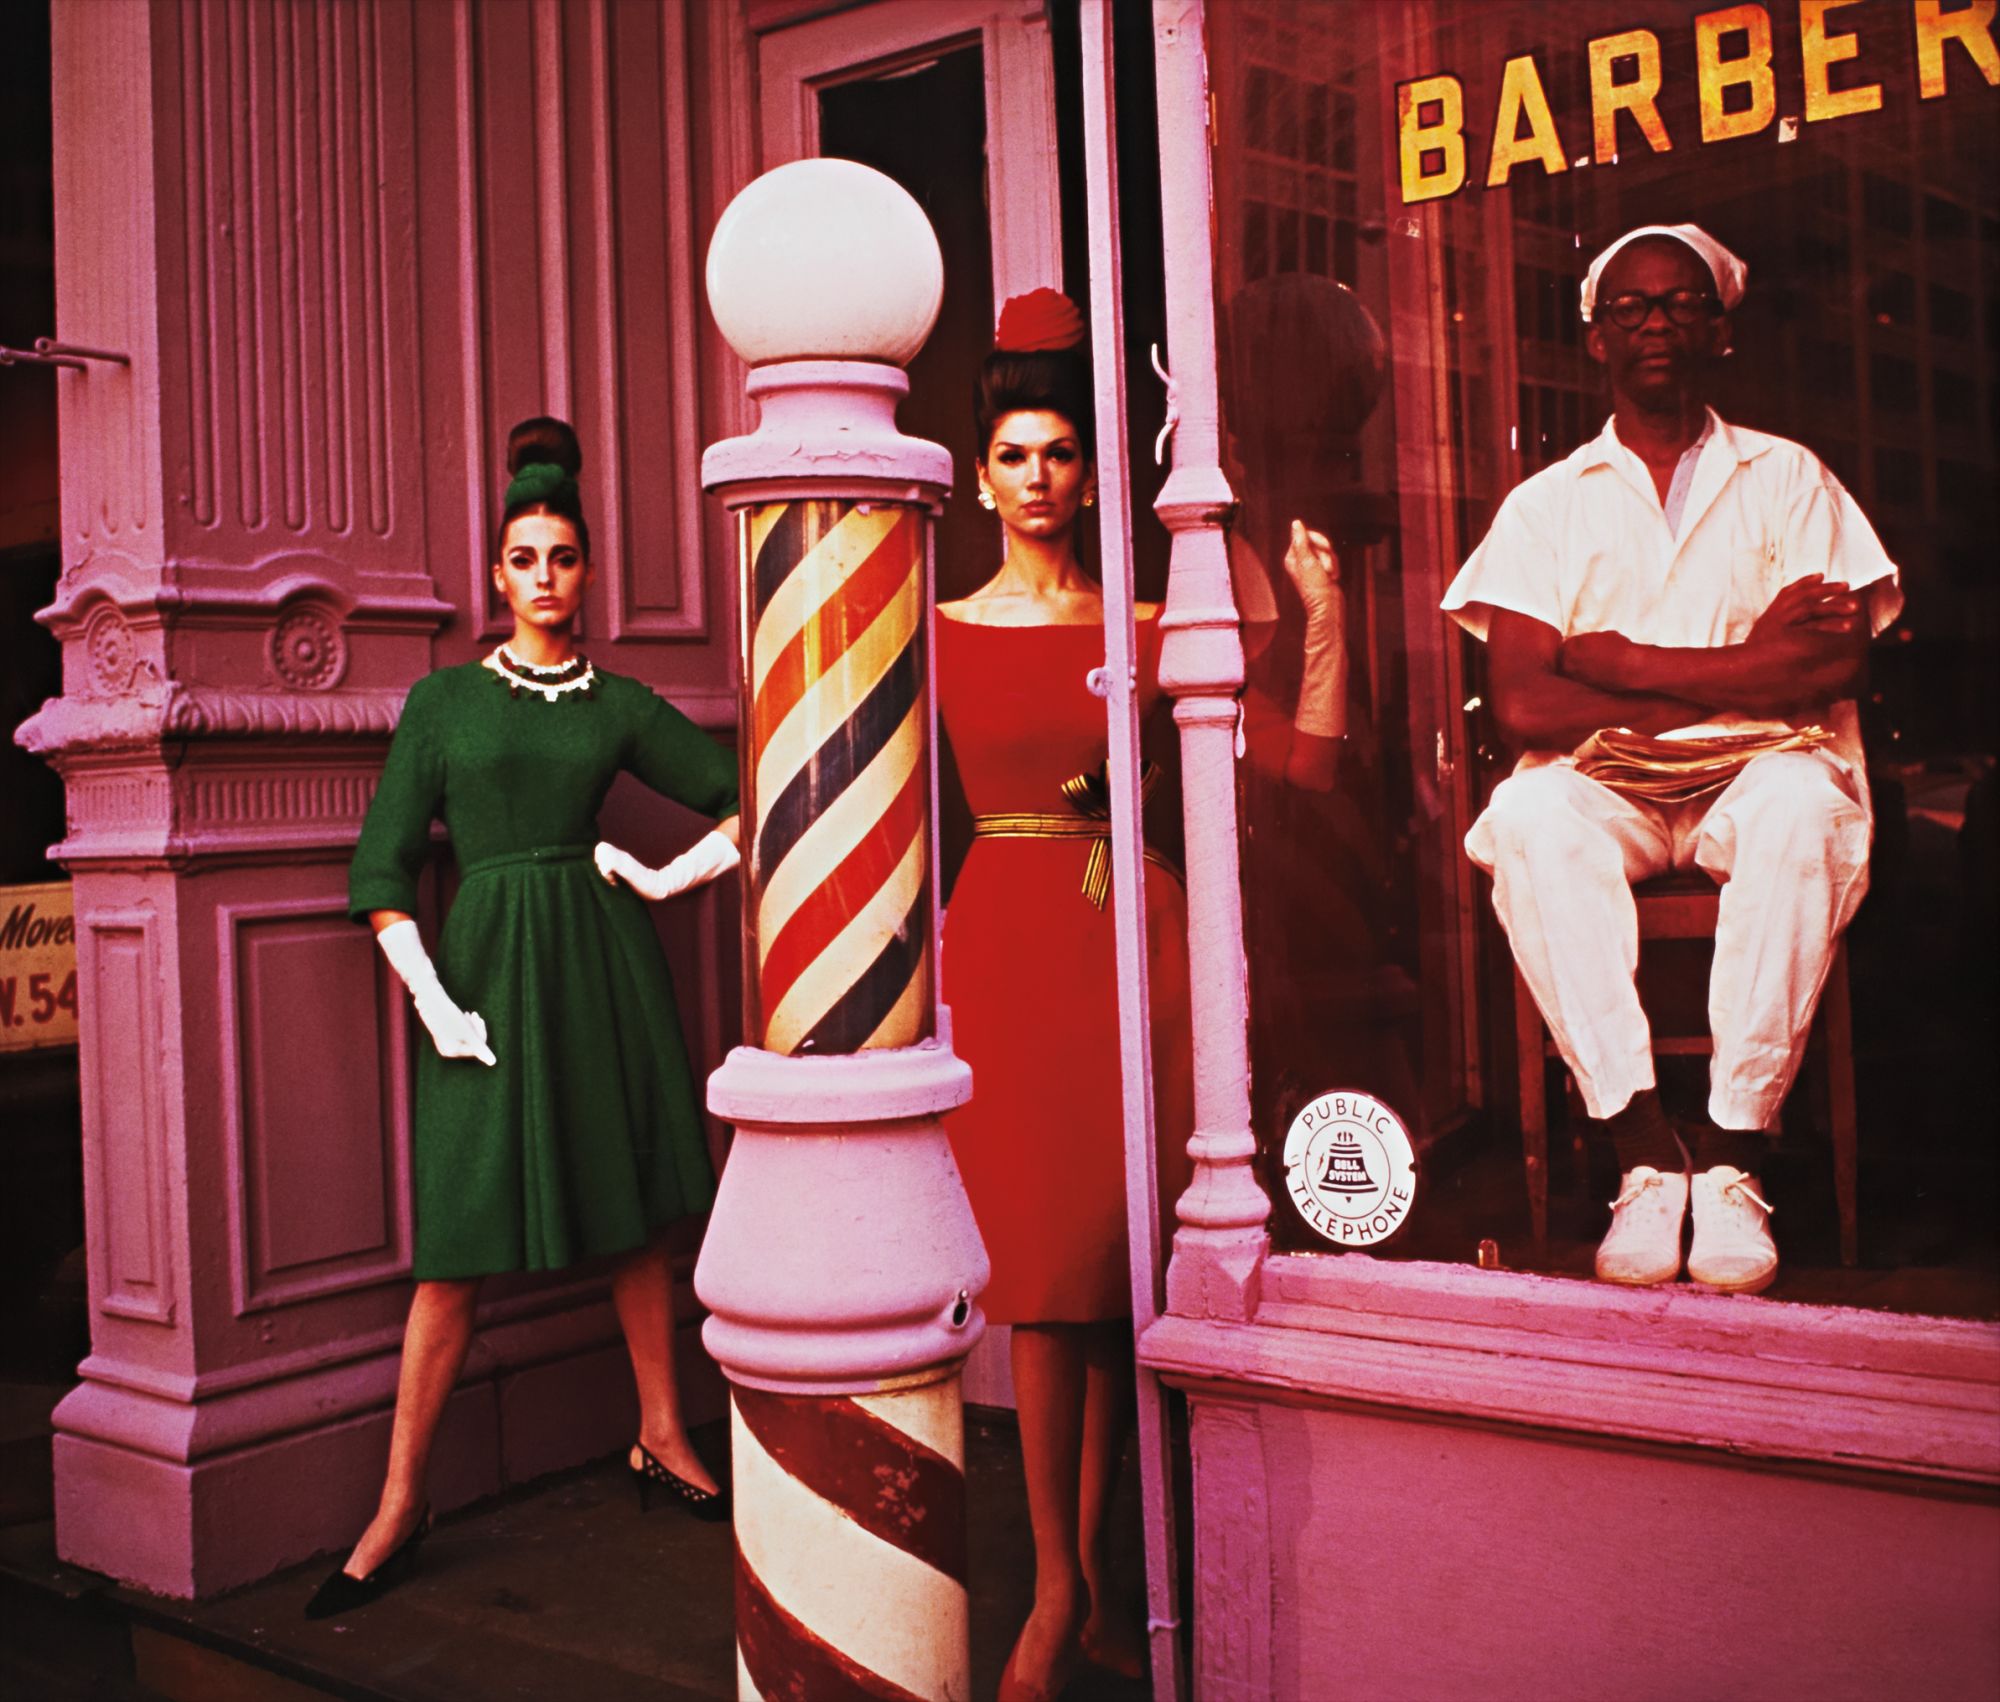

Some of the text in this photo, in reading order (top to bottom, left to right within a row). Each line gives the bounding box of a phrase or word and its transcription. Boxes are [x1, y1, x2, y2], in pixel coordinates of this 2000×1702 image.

[1398, 0, 2000, 203] BARBER
[1302, 1098, 1391, 1135] PUBLIC
[1328, 1169, 1367, 1183] SYSTEM
[1334, 1159, 1361, 1171] BELL
[1294, 1180, 1409, 1241] TELEPHONE
